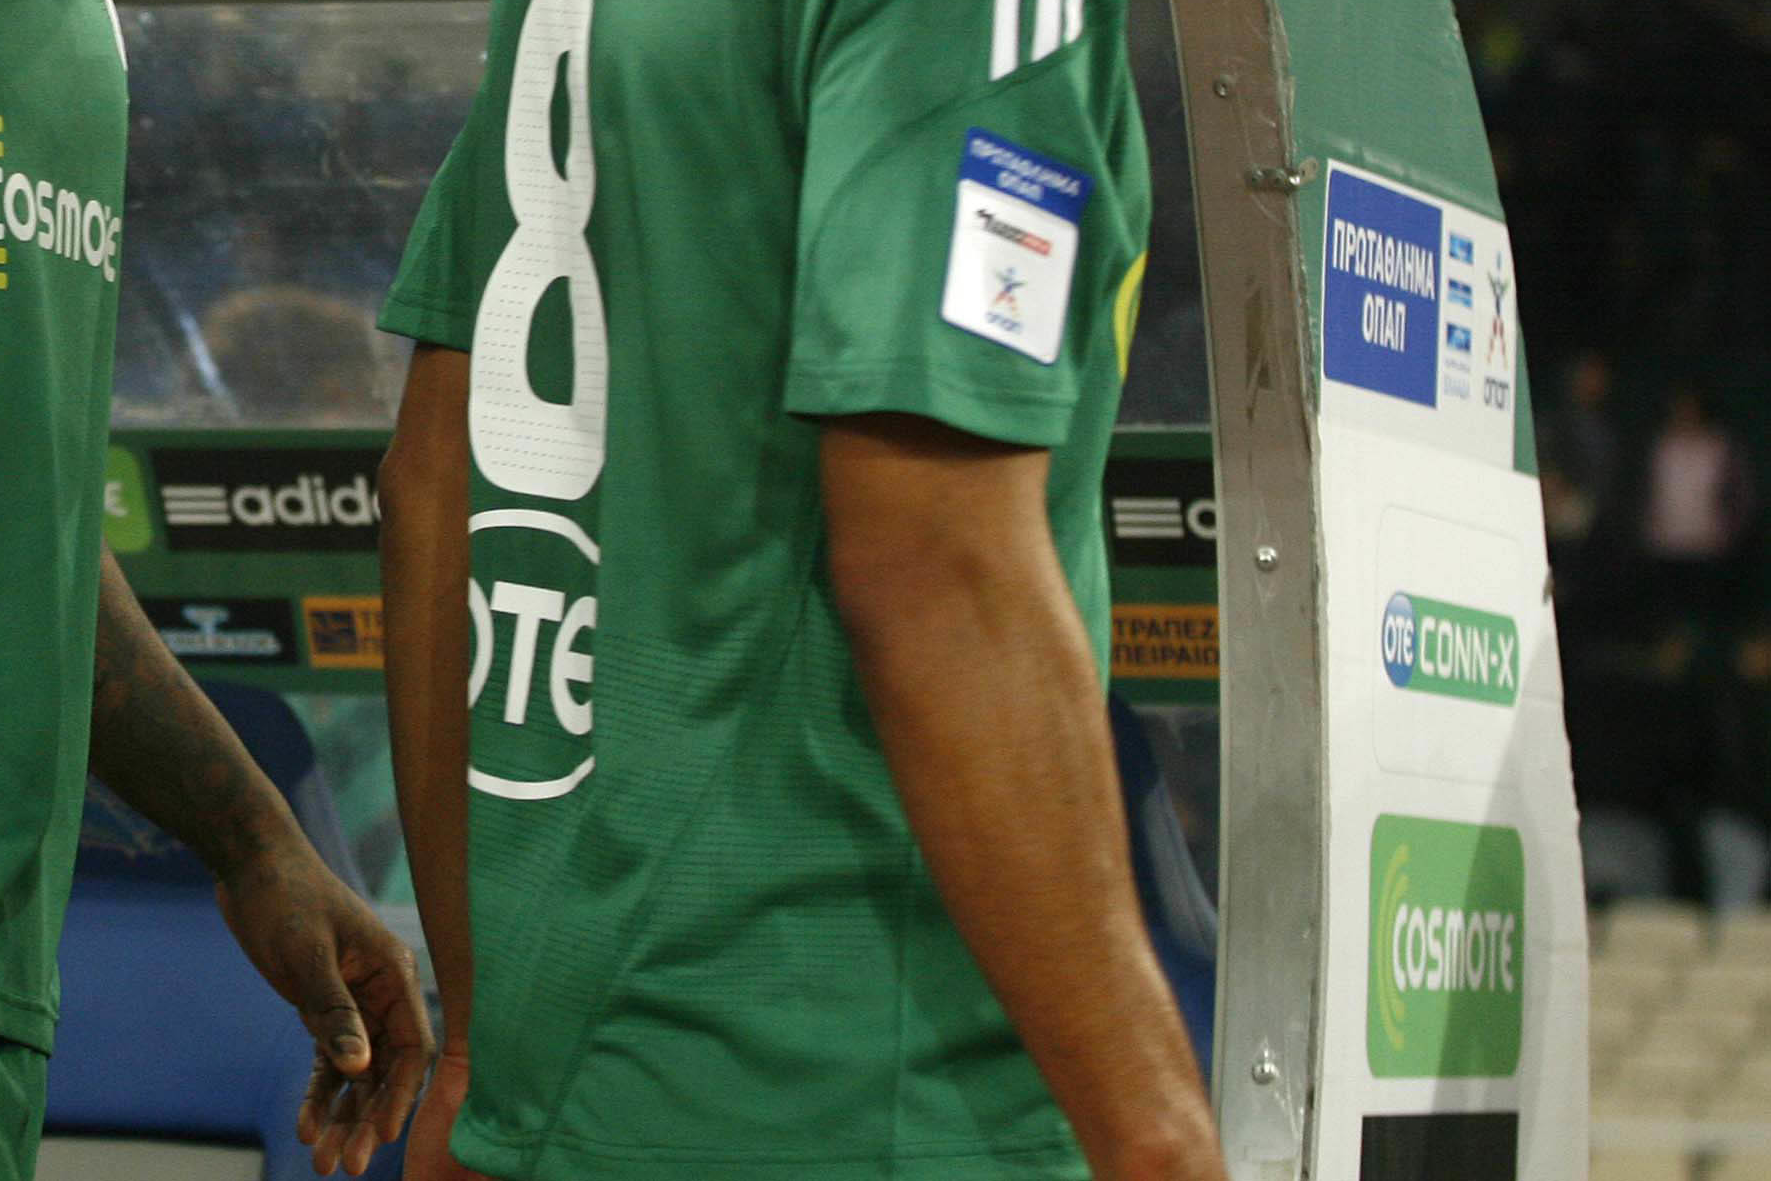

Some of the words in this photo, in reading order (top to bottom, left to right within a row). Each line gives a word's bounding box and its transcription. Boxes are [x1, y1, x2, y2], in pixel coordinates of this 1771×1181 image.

[1332, 218, 1436, 302] ΠΡΩΤΑΘΛΗΜΑ
[1361, 293, 1407, 354] ΟΠΑΠ
[231, 473, 382, 526] adid
[1383, 622, 1415, 667] OTE
[1419, 614, 1515, 692] CONN-X
[1391, 902, 1516, 994] COSMOTE
